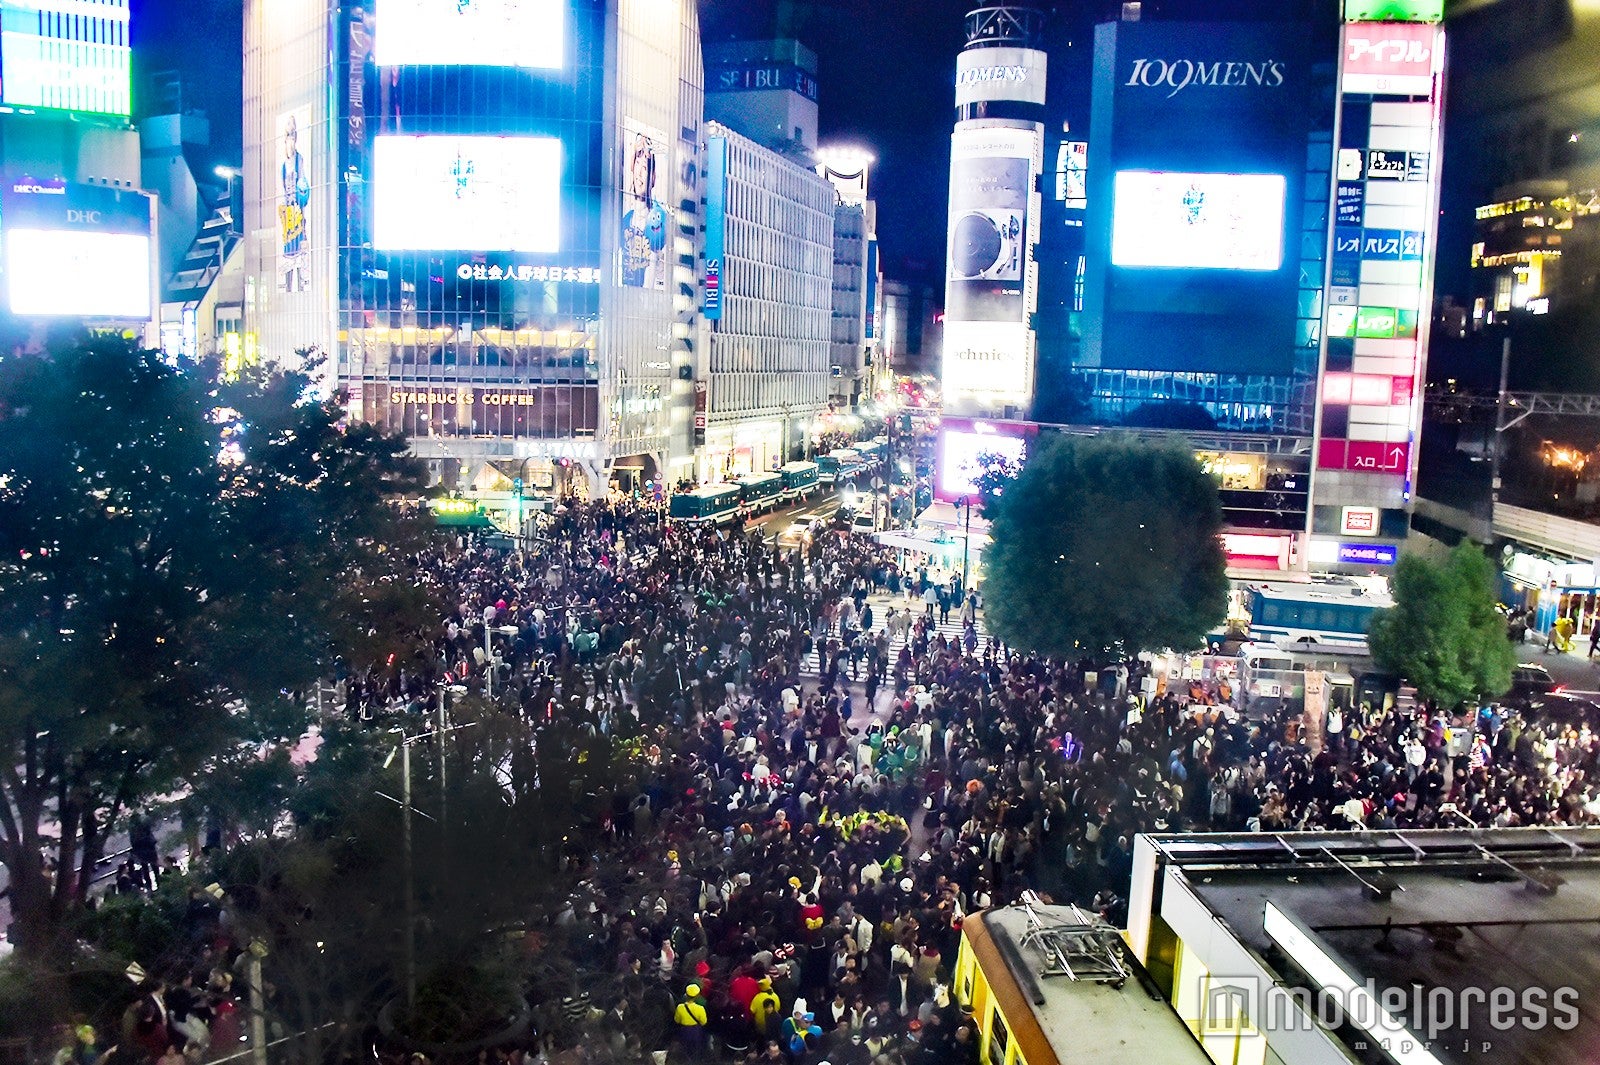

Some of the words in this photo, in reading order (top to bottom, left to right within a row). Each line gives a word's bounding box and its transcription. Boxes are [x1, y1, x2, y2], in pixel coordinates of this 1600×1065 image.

[1347, 38, 1430, 63] アイフル
[66, 209, 101, 223] DHC
[706, 259, 718, 308] SEIBU
[391, 392, 475, 405] STARBUCKS
[482, 394, 534, 406] COFFEE
[1354, 456, 1376, 468] 入口
